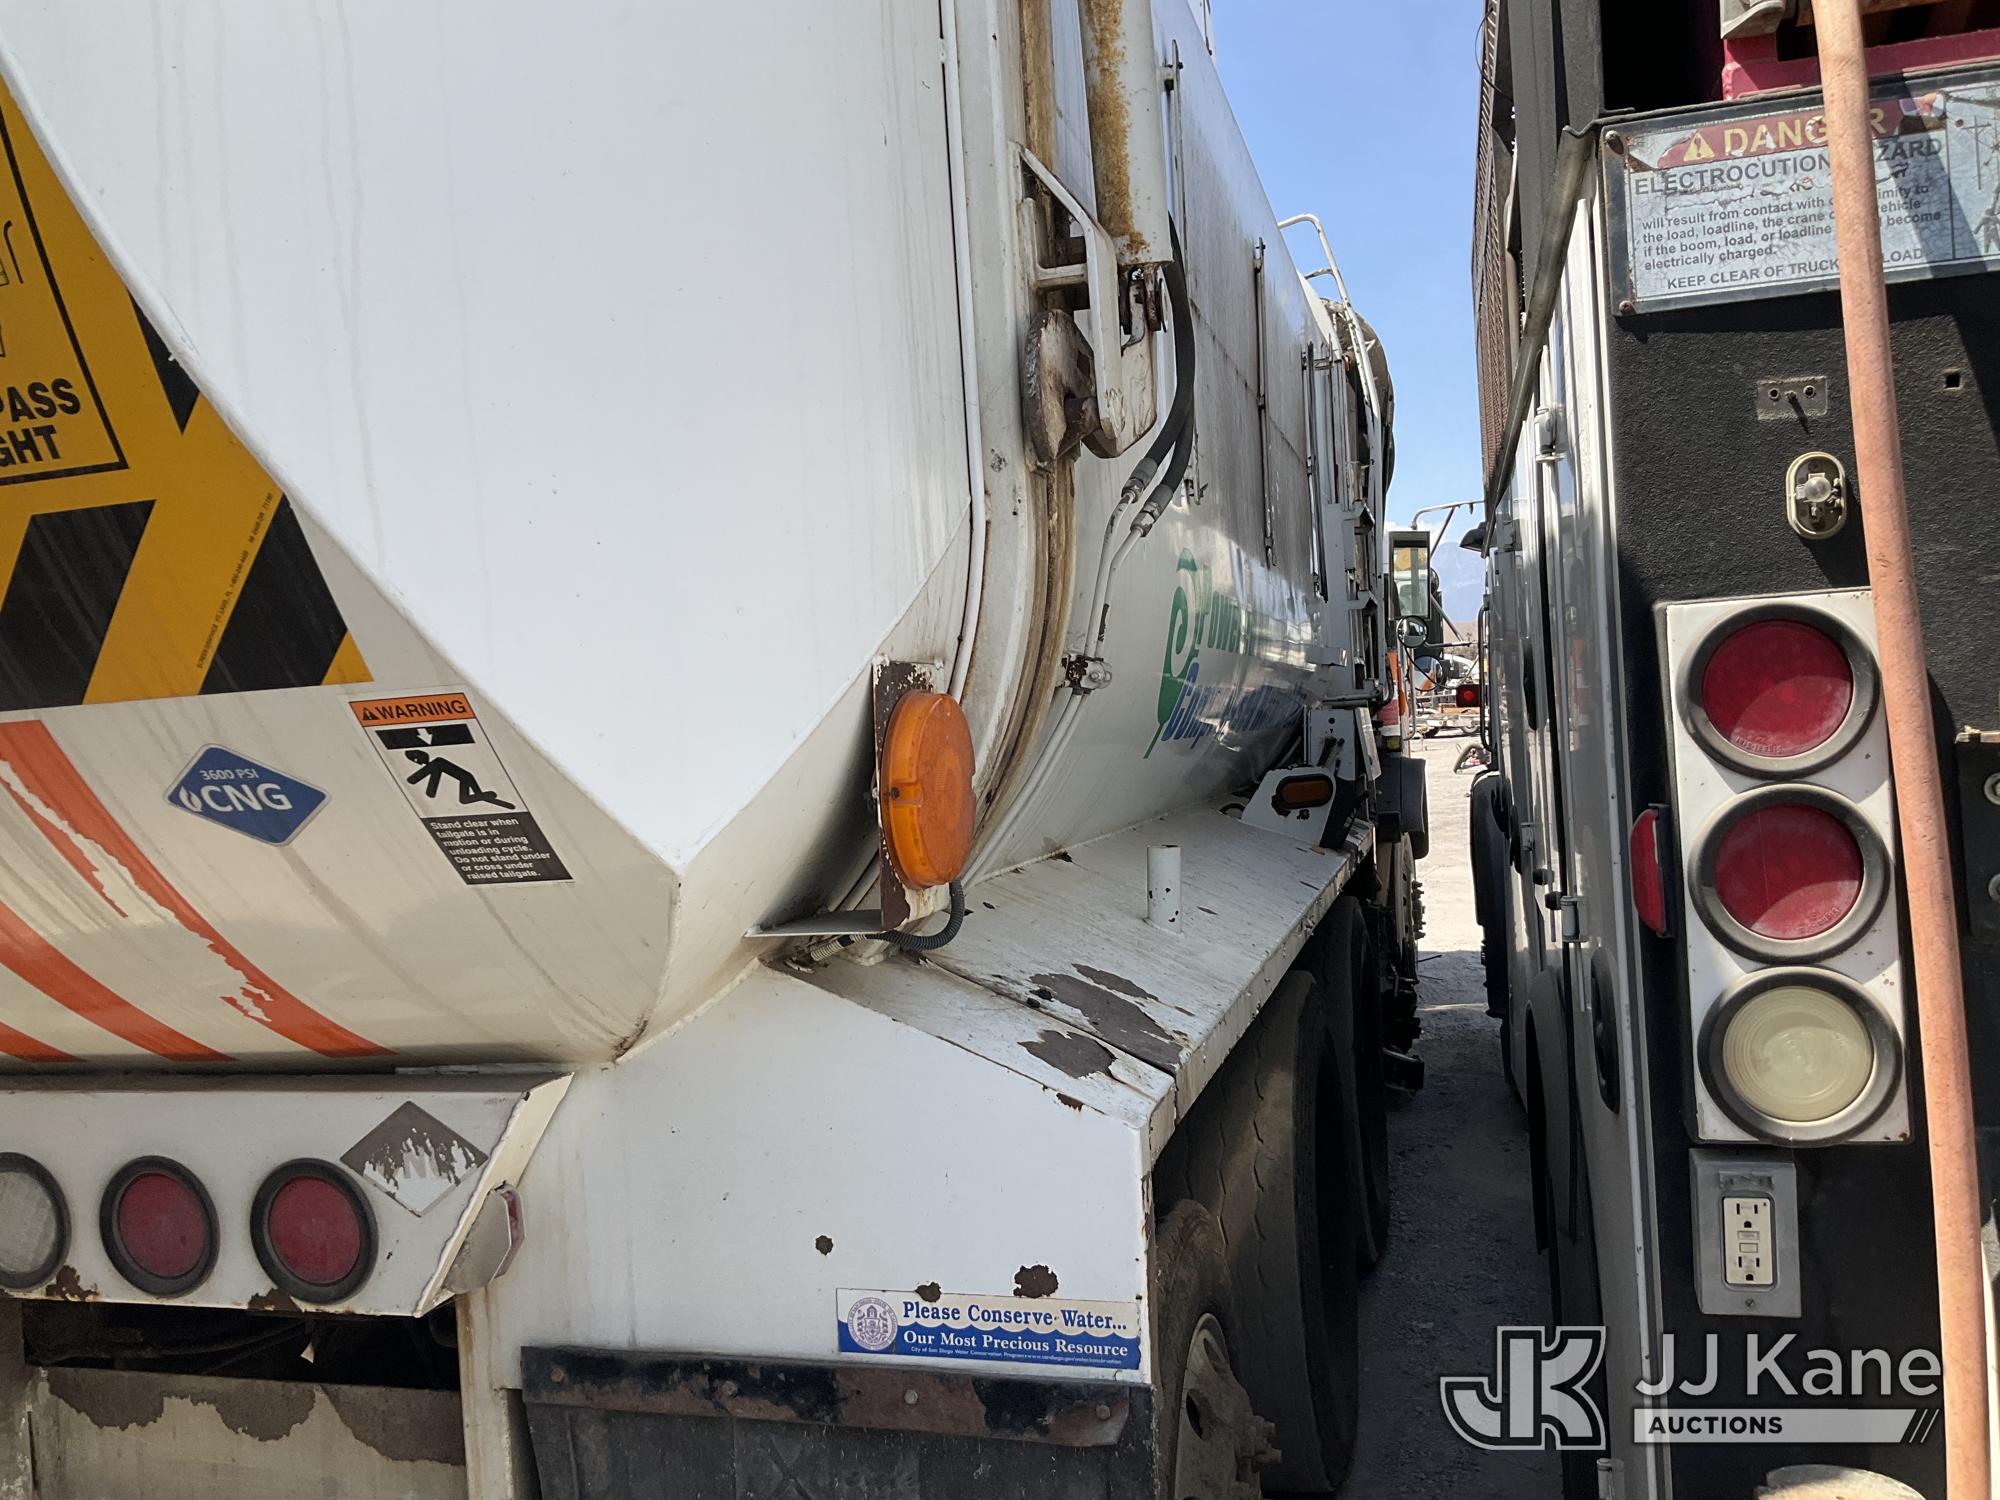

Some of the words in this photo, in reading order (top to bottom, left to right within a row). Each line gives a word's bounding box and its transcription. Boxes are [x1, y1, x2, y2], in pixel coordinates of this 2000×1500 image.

[1724, 108, 1887, 157] DANGR
[1634, 153, 1831, 196] ELECTROCUTION
[1876, 139, 1942, 163] ZARD
[1642, 217, 1664, 230] will
[1667, 211, 1705, 227] result
[1709, 207, 1739, 223] from
[1743, 200, 1793, 217] contact
[1797, 196, 1825, 210] with
[1643, 231, 1663, 244] the
[1667, 227, 1699, 242] load,
[1703, 220, 1758, 237] loadline,
[1762, 216, 1783, 229] the
[1787, 210, 1825, 226] crane
[1880, 199, 1921, 214] ehicle
[1643, 246, 1652, 258] if
[1656, 243, 1676, 255] the
[1680, 238, 1721, 253] boom,
[1725, 233, 1757, 248] load,
[1761, 231, 1775, 242] or
[1779, 224, 1832, 242] loadline
[1886, 211, 1942, 227] become
[1645, 252, 1715, 271] electrically
[1719, 244, 1776, 263] charged.
[1710, 267, 1760, 285] CLEAR
[1764, 265, 1784, 278] OF
[1789, 258, 1839, 275] TRUCK
[0, 378, 81, 422] ASS
[376, 699, 467, 720] WARNING
[200, 768, 235, 781] 3600
[236, 768, 259, 781] PSI
[200, 782, 293, 812] CNG
[430, 821, 462, 831] Stand
[464, 819, 489, 829] clear
[491, 818, 519, 828] when
[436, 829, 475, 840] tailgate
[477, 829, 487, 837] is
[489, 828, 500, 836] in
[443, 838, 480, 848] motion
[481, 838, 492, 846] or
[494, 835, 530, 846] during
[449, 846, 501, 856] unloading
[502, 844, 533, 854] cycle.
[454, 856, 471, 864] Do
[471, 855, 490, 864] not
[490, 853, 520, 862] stand
[521, 851, 552, 861] under
[474, 863, 503, 871] cross
[504, 861, 534, 870] under
[466, 871, 499, 881] raised
[500, 869, 542, 880] tailgate.
[903, 1300, 961, 1322] Please
[967, 1304, 1054, 1327] Conserve
[1060, 1308, 1128, 1331] Water...
[903, 1330, 936, 1345] Our
[940, 1332, 978, 1348] Most
[982, 1334, 1050, 1353] Precious
[1055, 1338, 1129, 1357] Resource
